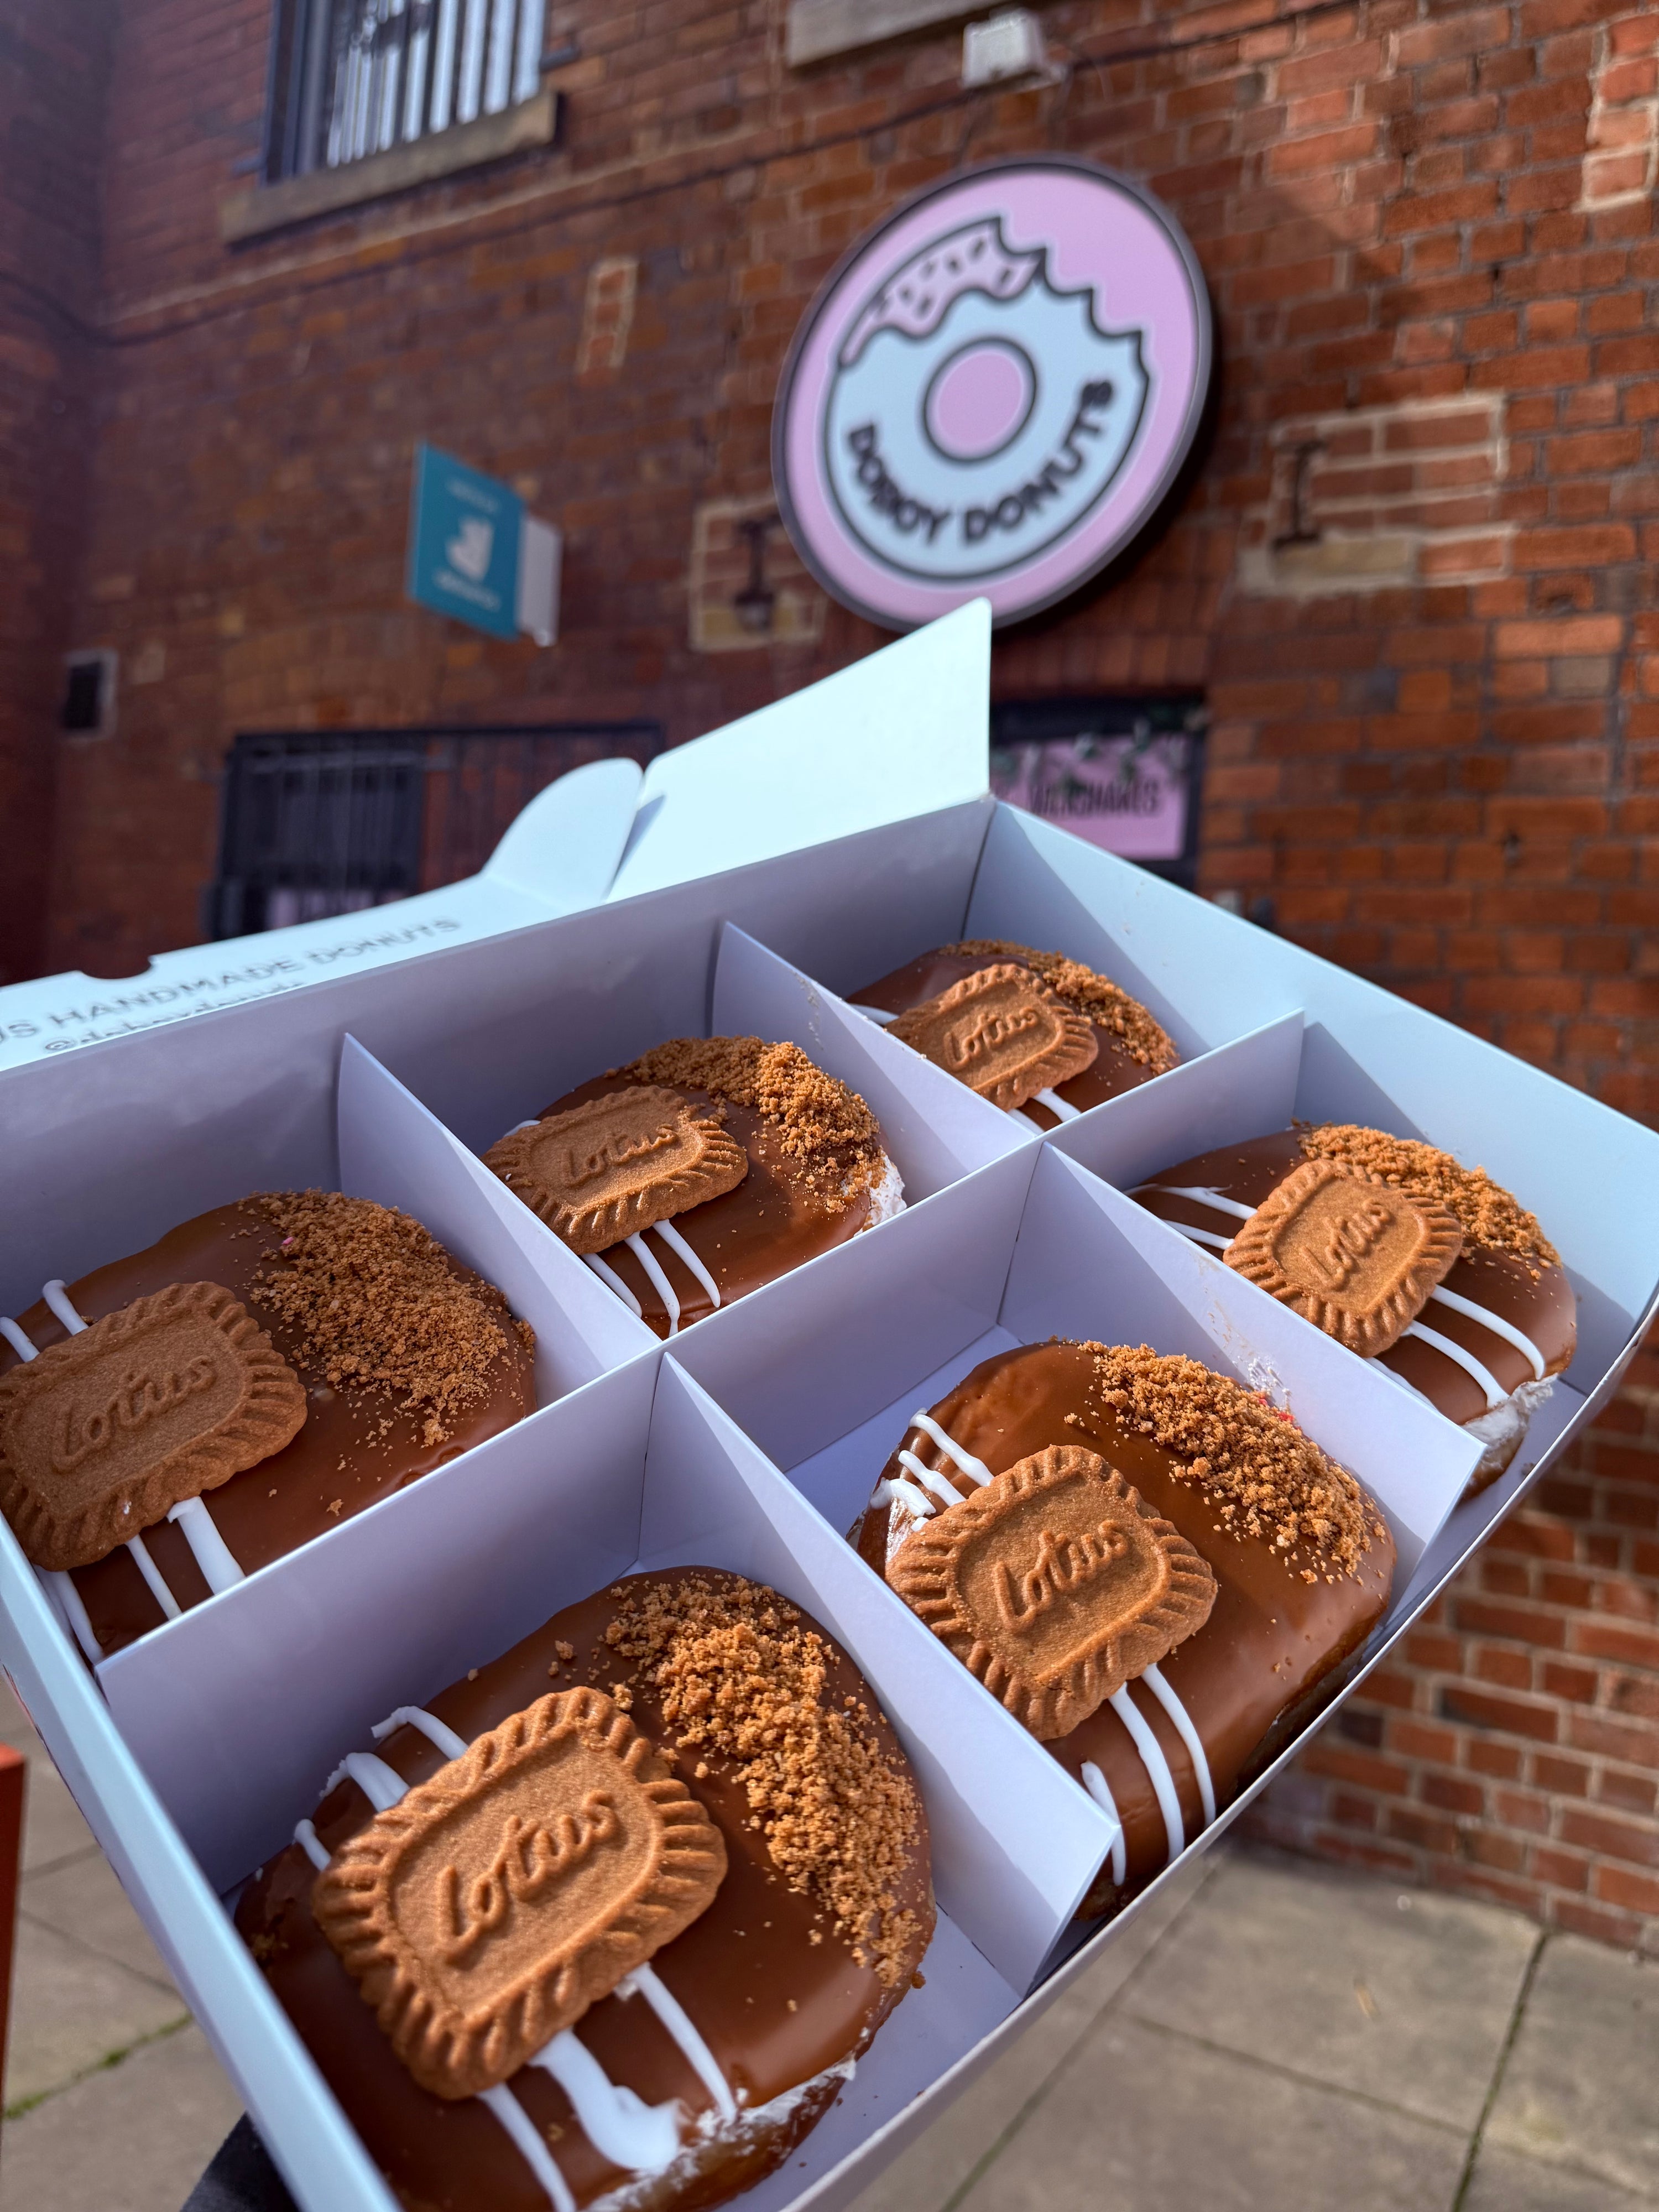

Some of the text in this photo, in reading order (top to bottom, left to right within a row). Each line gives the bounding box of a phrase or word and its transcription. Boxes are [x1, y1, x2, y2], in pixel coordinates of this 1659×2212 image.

[964, 379, 1113, 544] DONUTS
[48, 954, 306, 1028] HANDMADE
[304, 918, 461, 964] DONUTS
